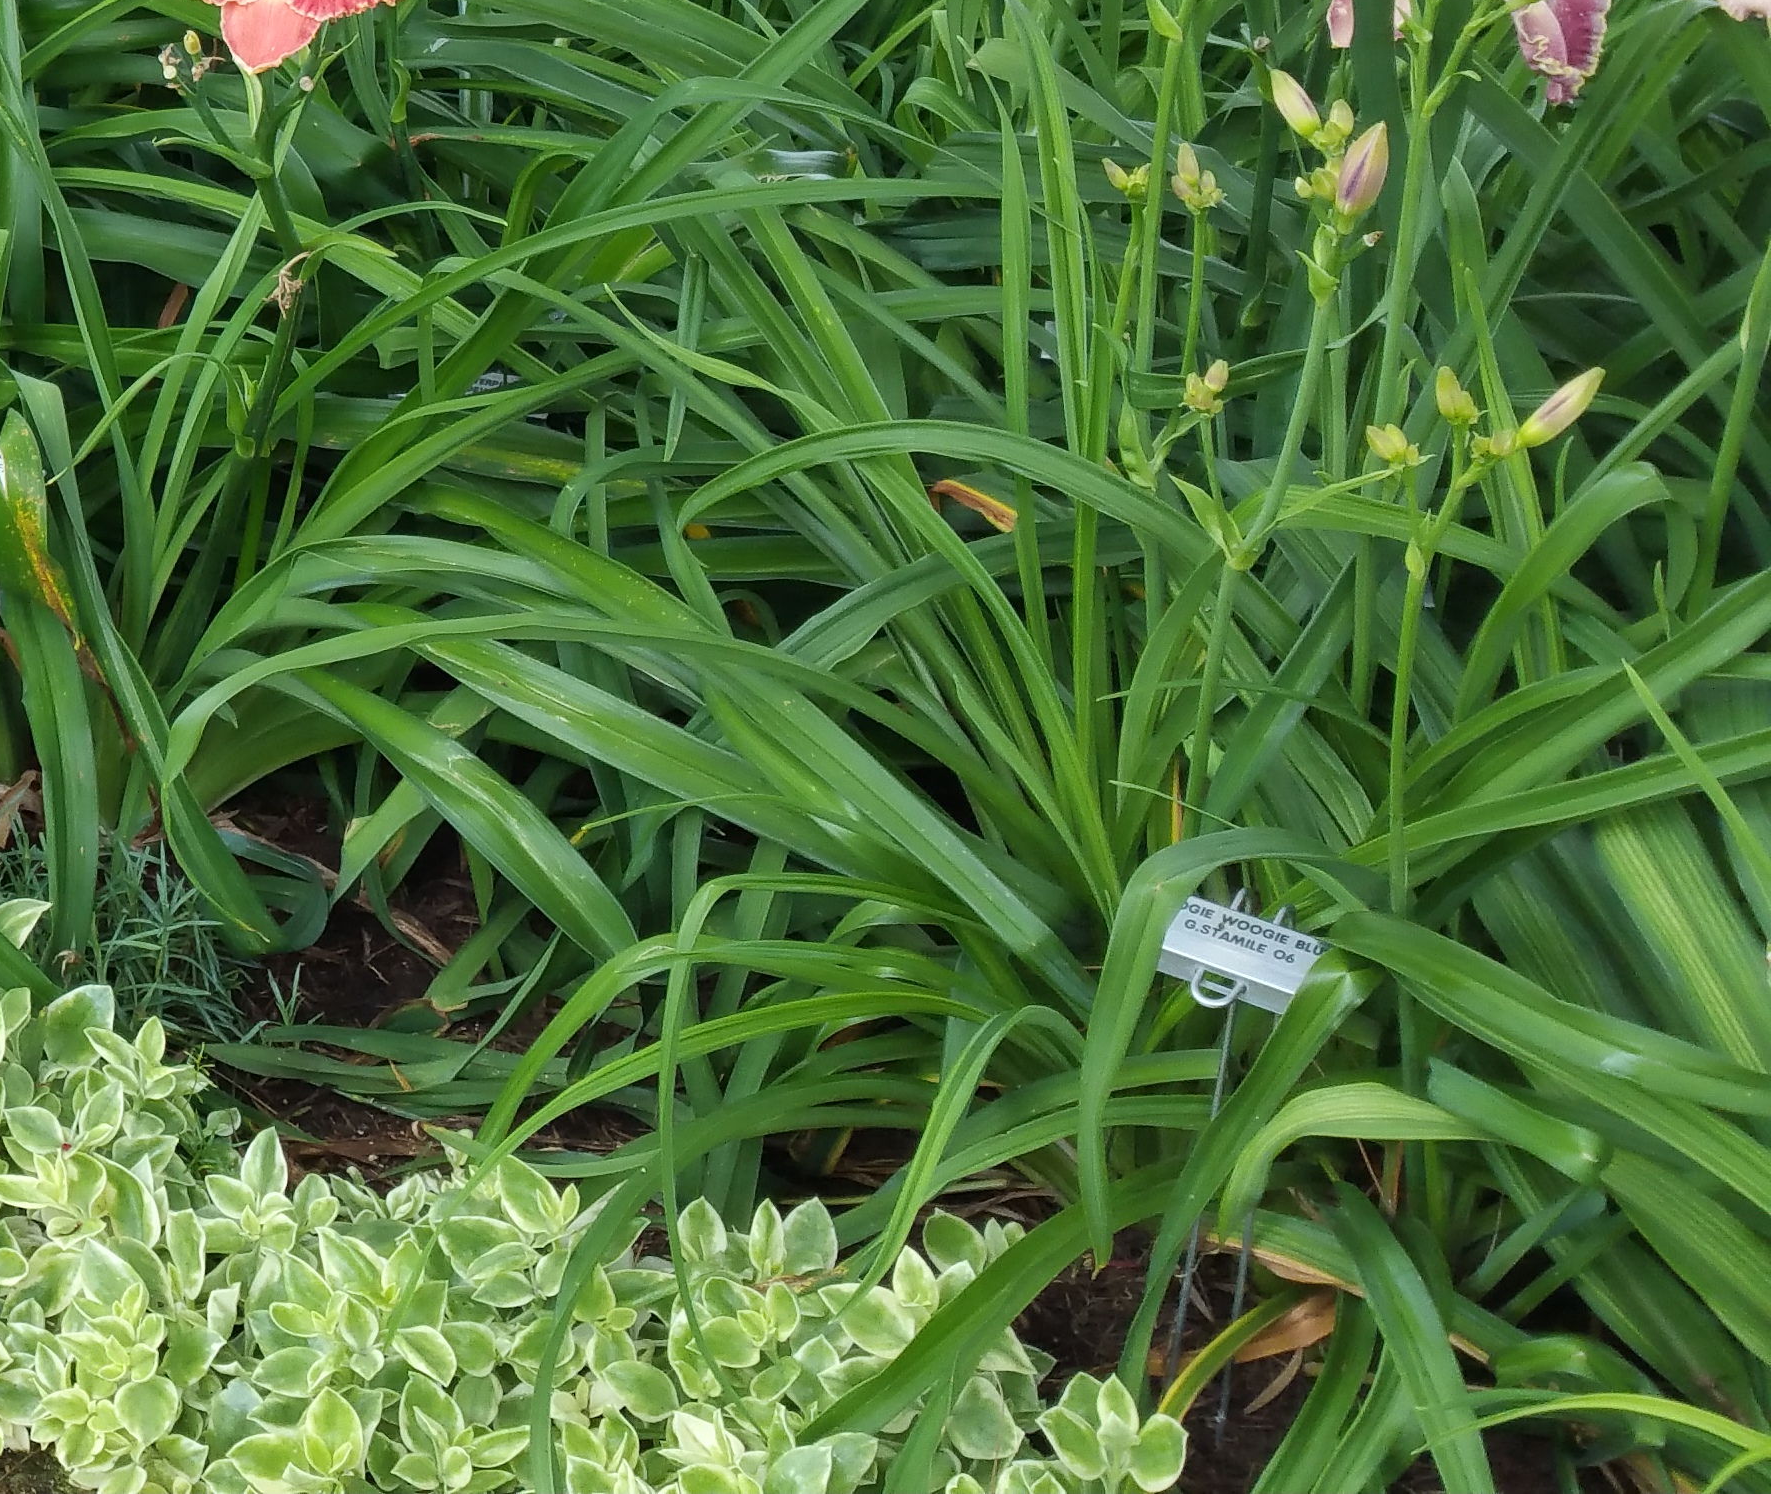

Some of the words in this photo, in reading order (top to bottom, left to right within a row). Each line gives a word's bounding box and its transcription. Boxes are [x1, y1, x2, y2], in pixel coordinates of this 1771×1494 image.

[1184, 918, 1268, 954] G.STAMILE
[1220, 913, 1291, 945] WOOGIE
[1294, 939, 1326, 956] BLU
